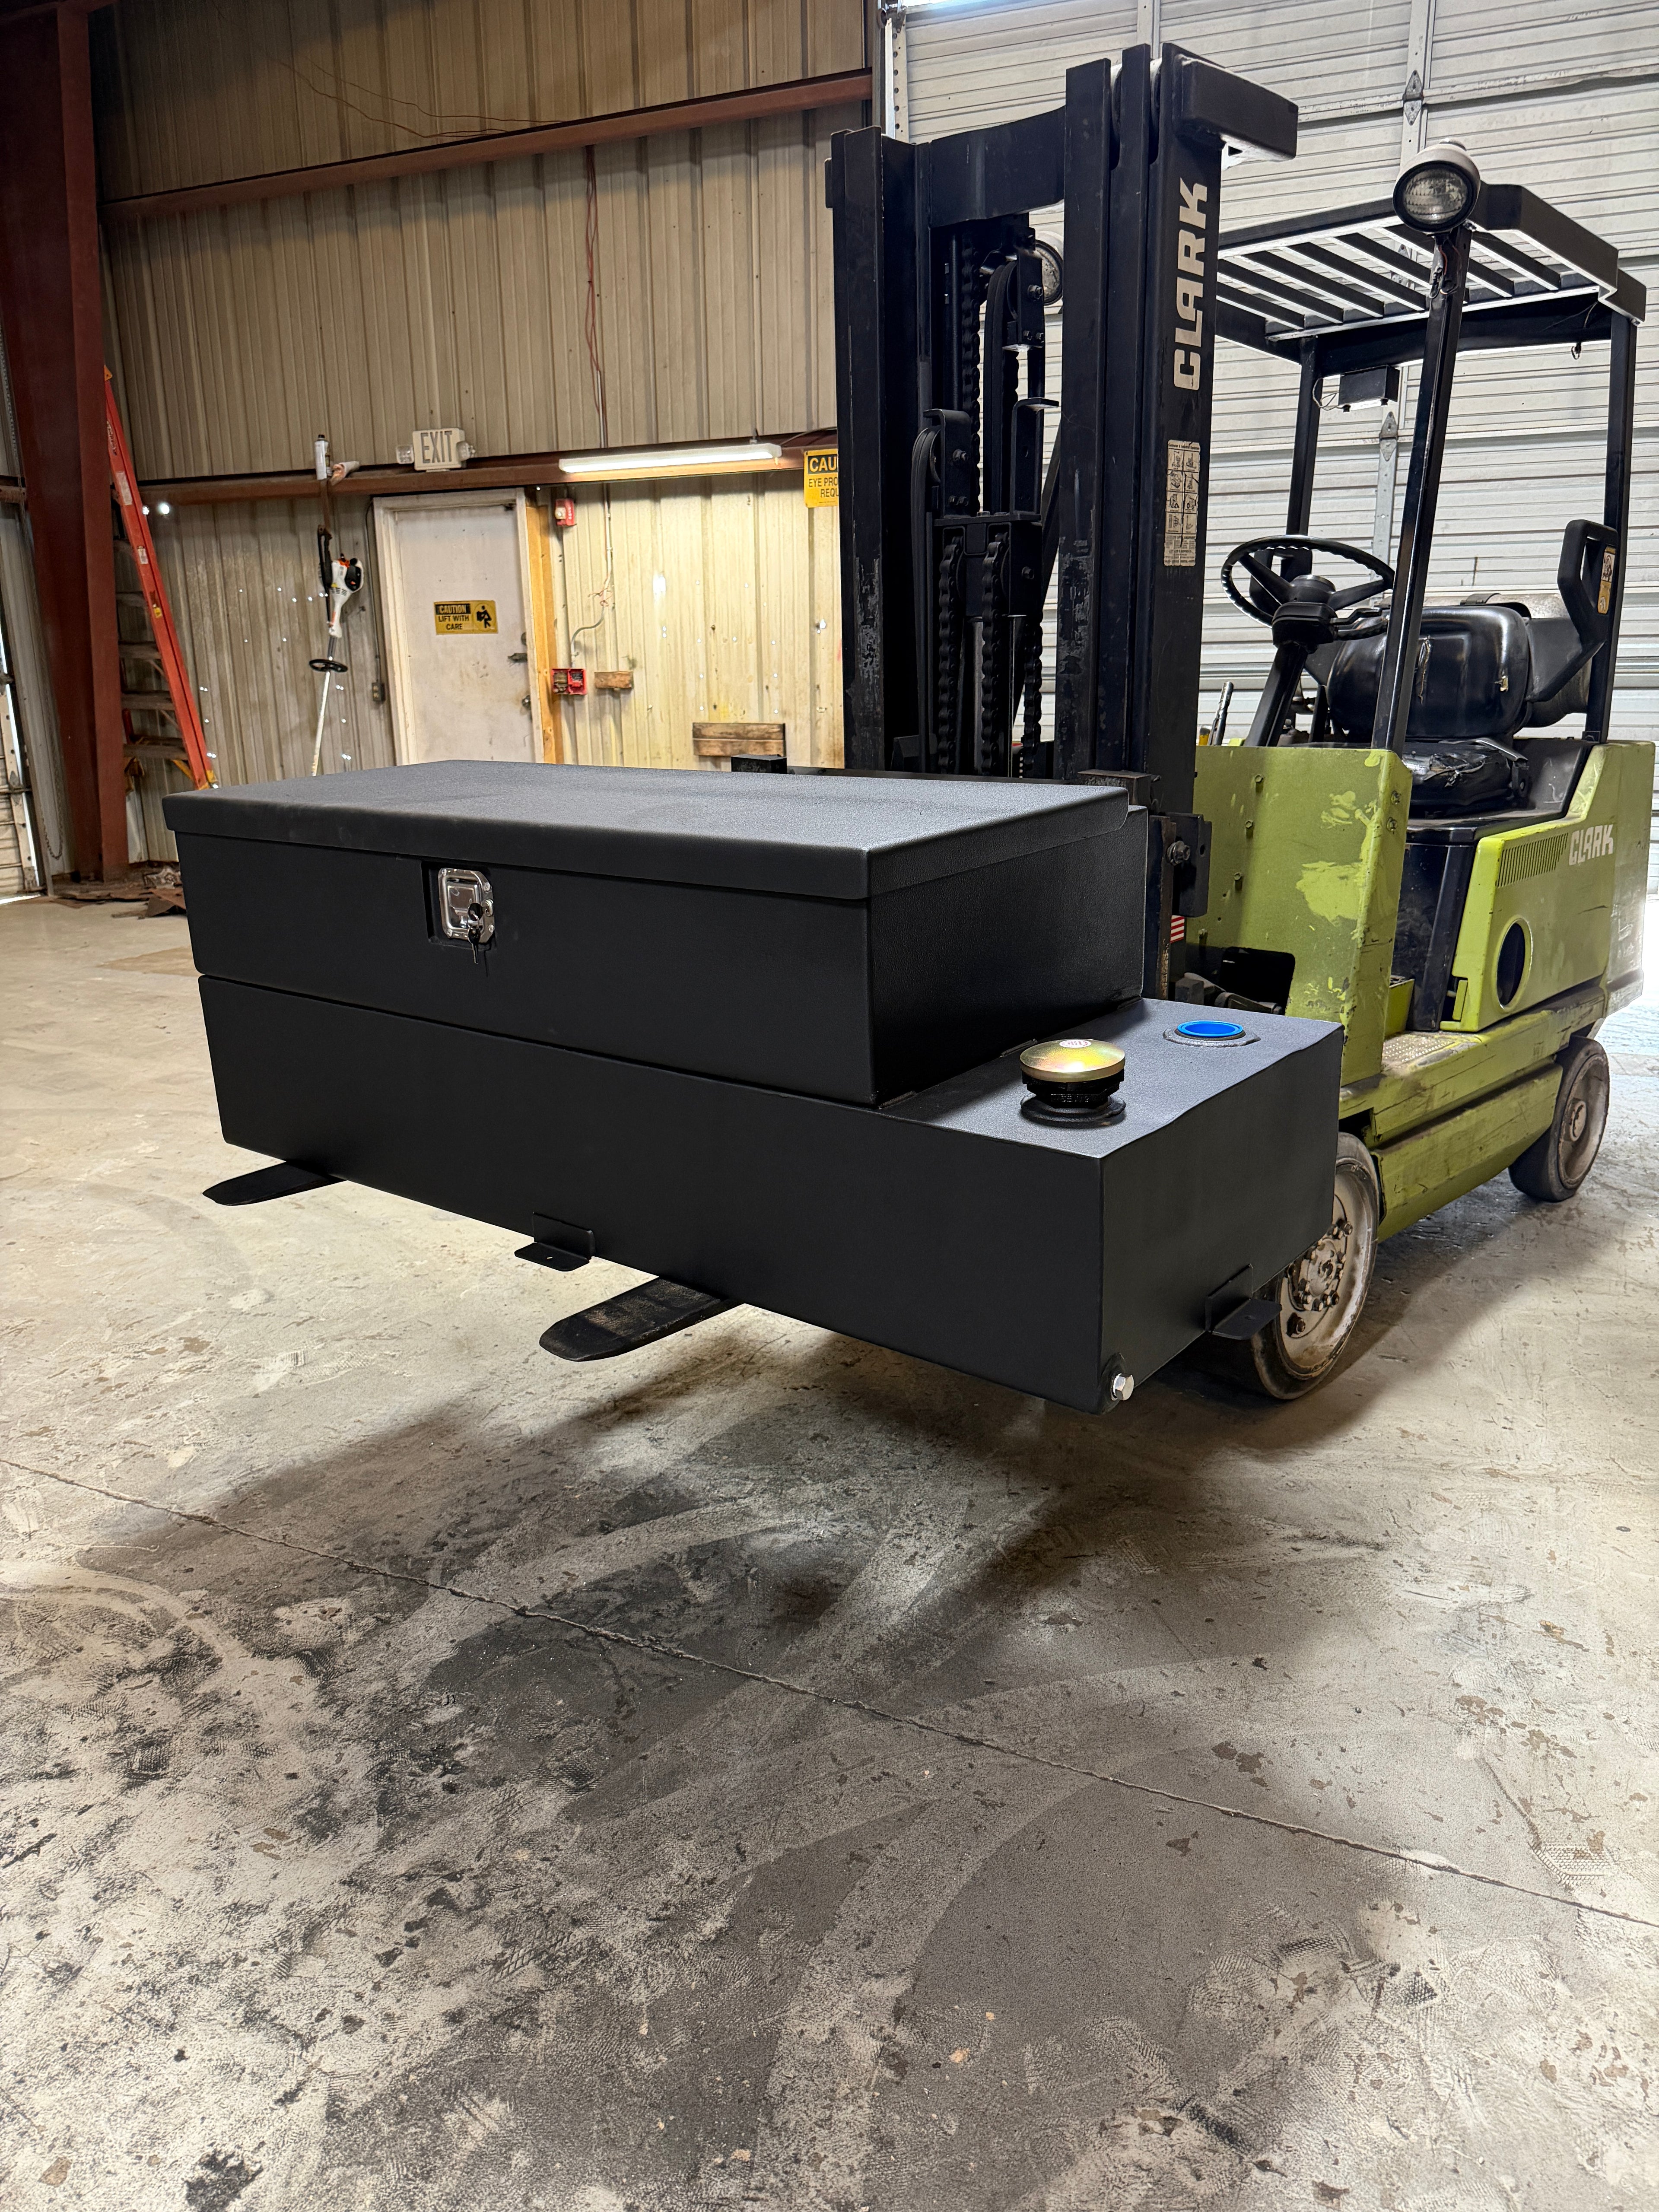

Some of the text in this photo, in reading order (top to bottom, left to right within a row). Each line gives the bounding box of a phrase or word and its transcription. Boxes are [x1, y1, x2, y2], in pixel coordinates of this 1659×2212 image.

[1174, 177, 1207, 391] CLARK
[421, 430, 452, 464] EXIT
[809, 456, 837, 472] CAU
[808, 477, 838, 487] EYE PRO
[439, 604, 467, 614] CAUTION
[1569, 824, 1614, 866] CLARK
